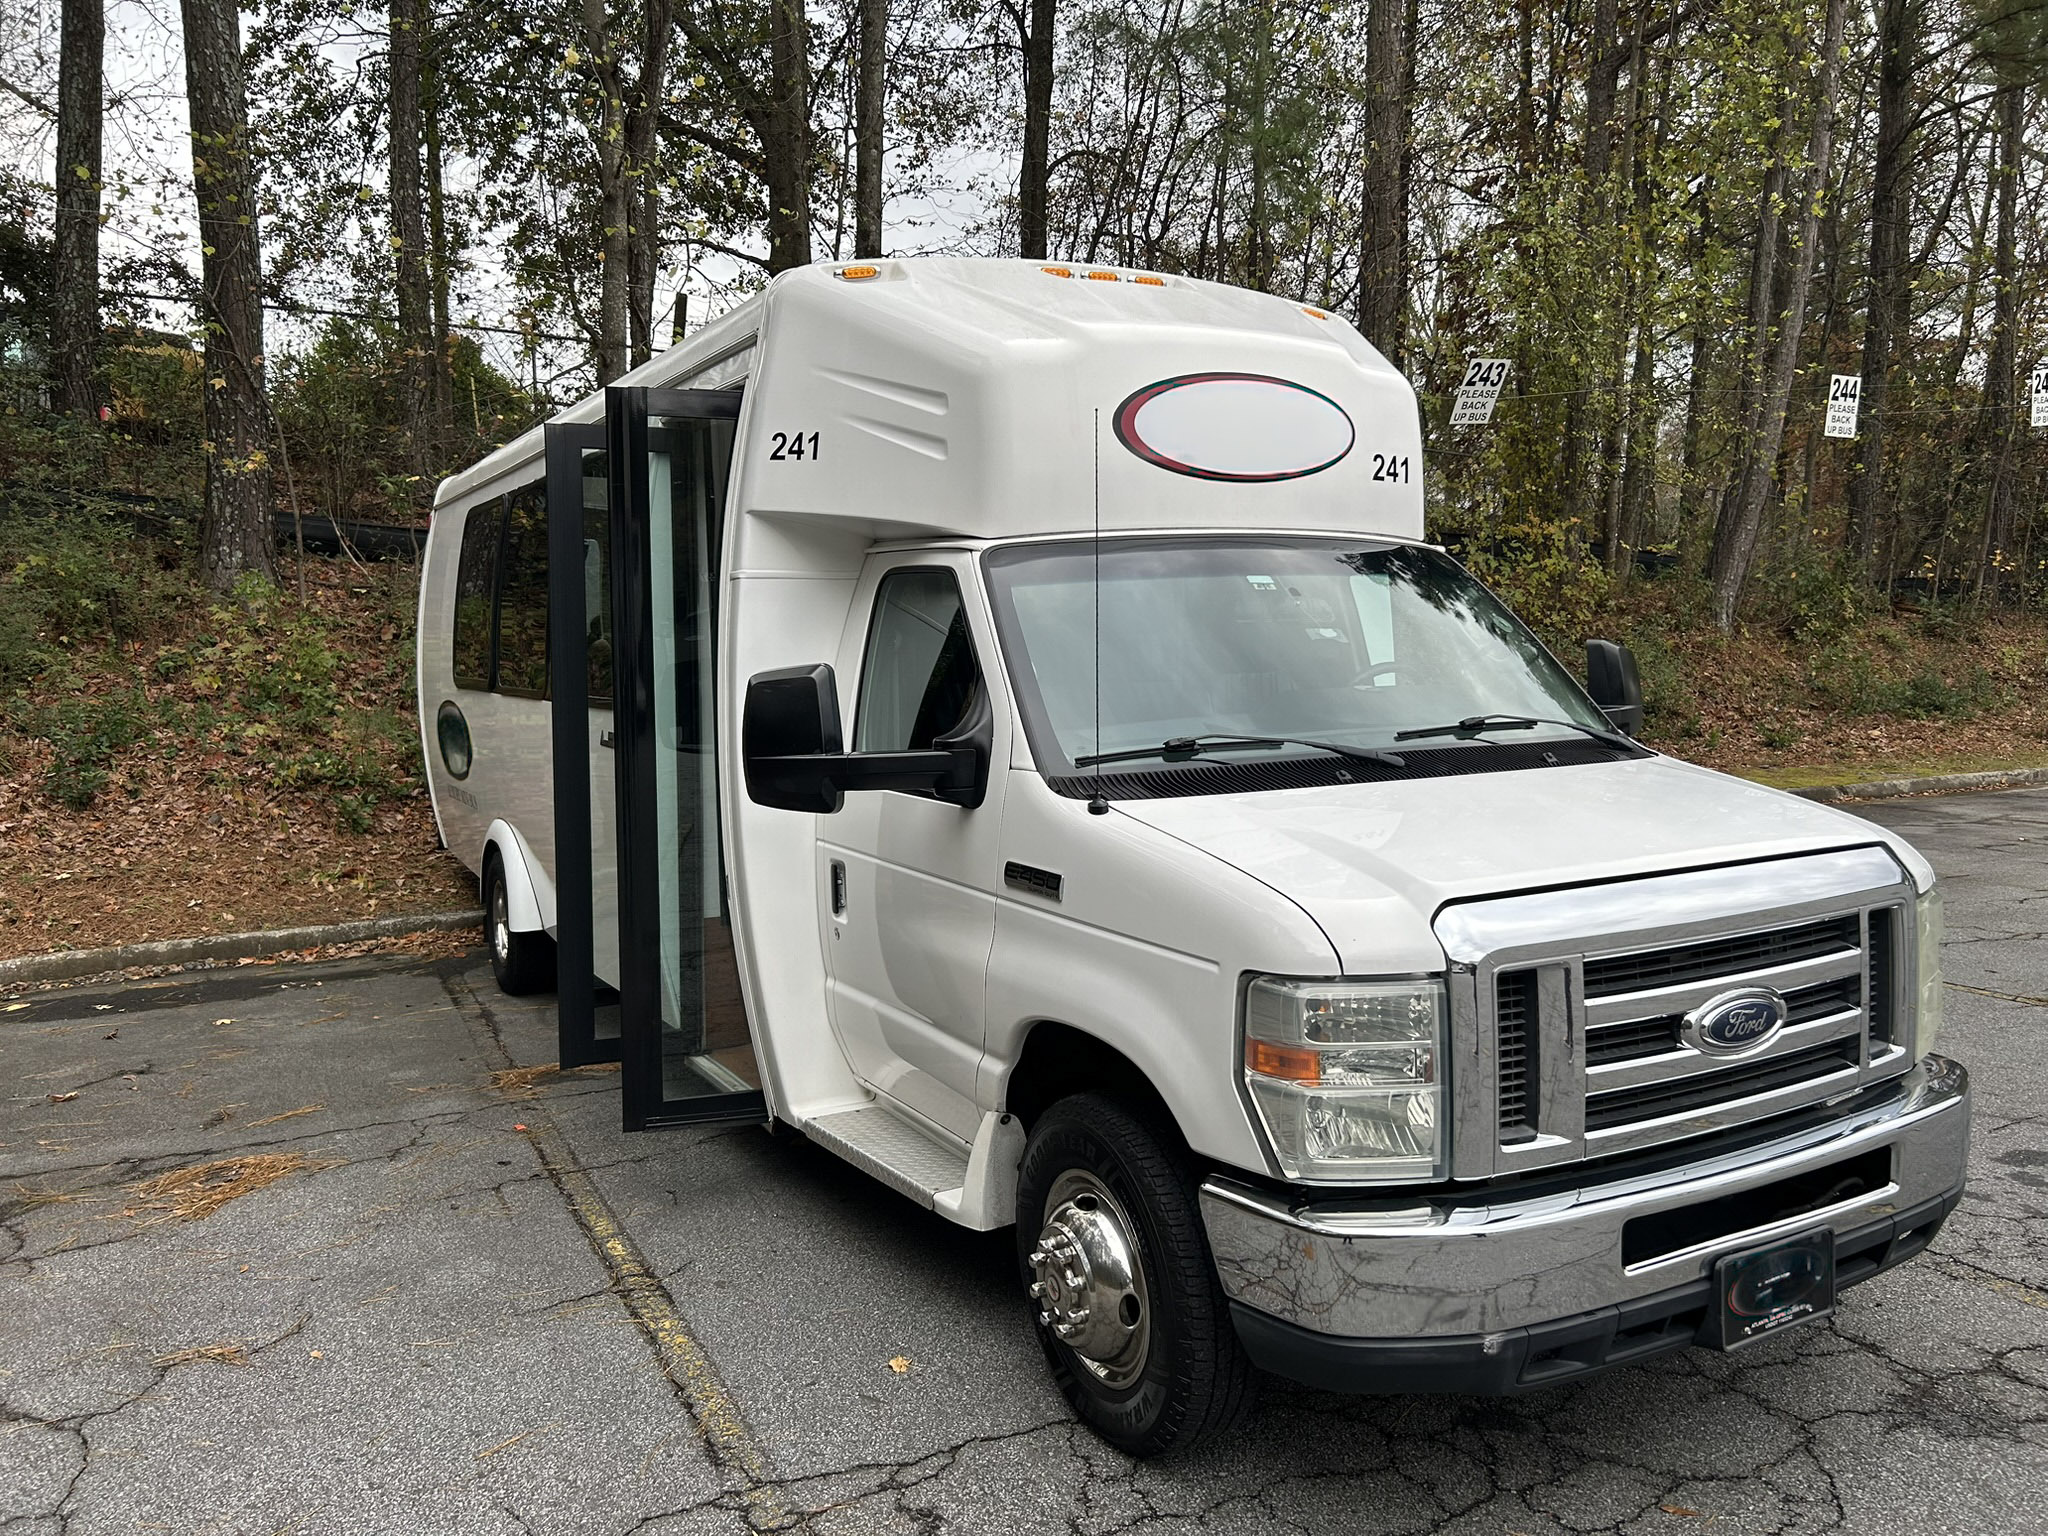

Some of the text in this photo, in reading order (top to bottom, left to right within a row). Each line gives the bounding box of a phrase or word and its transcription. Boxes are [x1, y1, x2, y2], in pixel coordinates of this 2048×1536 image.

[1465, 362, 1506, 387] 243
[1460, 390, 1498, 398] PLEASE
[1831, 378, 1858, 403] 244
[1461, 401, 1488, 410] BACK
[1829, 404, 1856, 414] PLEASE
[1453, 413, 1487, 421] UP BUS
[1831, 415, 1851, 424] BACK
[2033, 416, 2042, 424] UP
[1827, 426, 1853, 435] UP BUS
[770, 432, 820, 461] 241
[1372, 453, 1409, 484] 241
[1724, 1007, 1767, 1038] Ford
